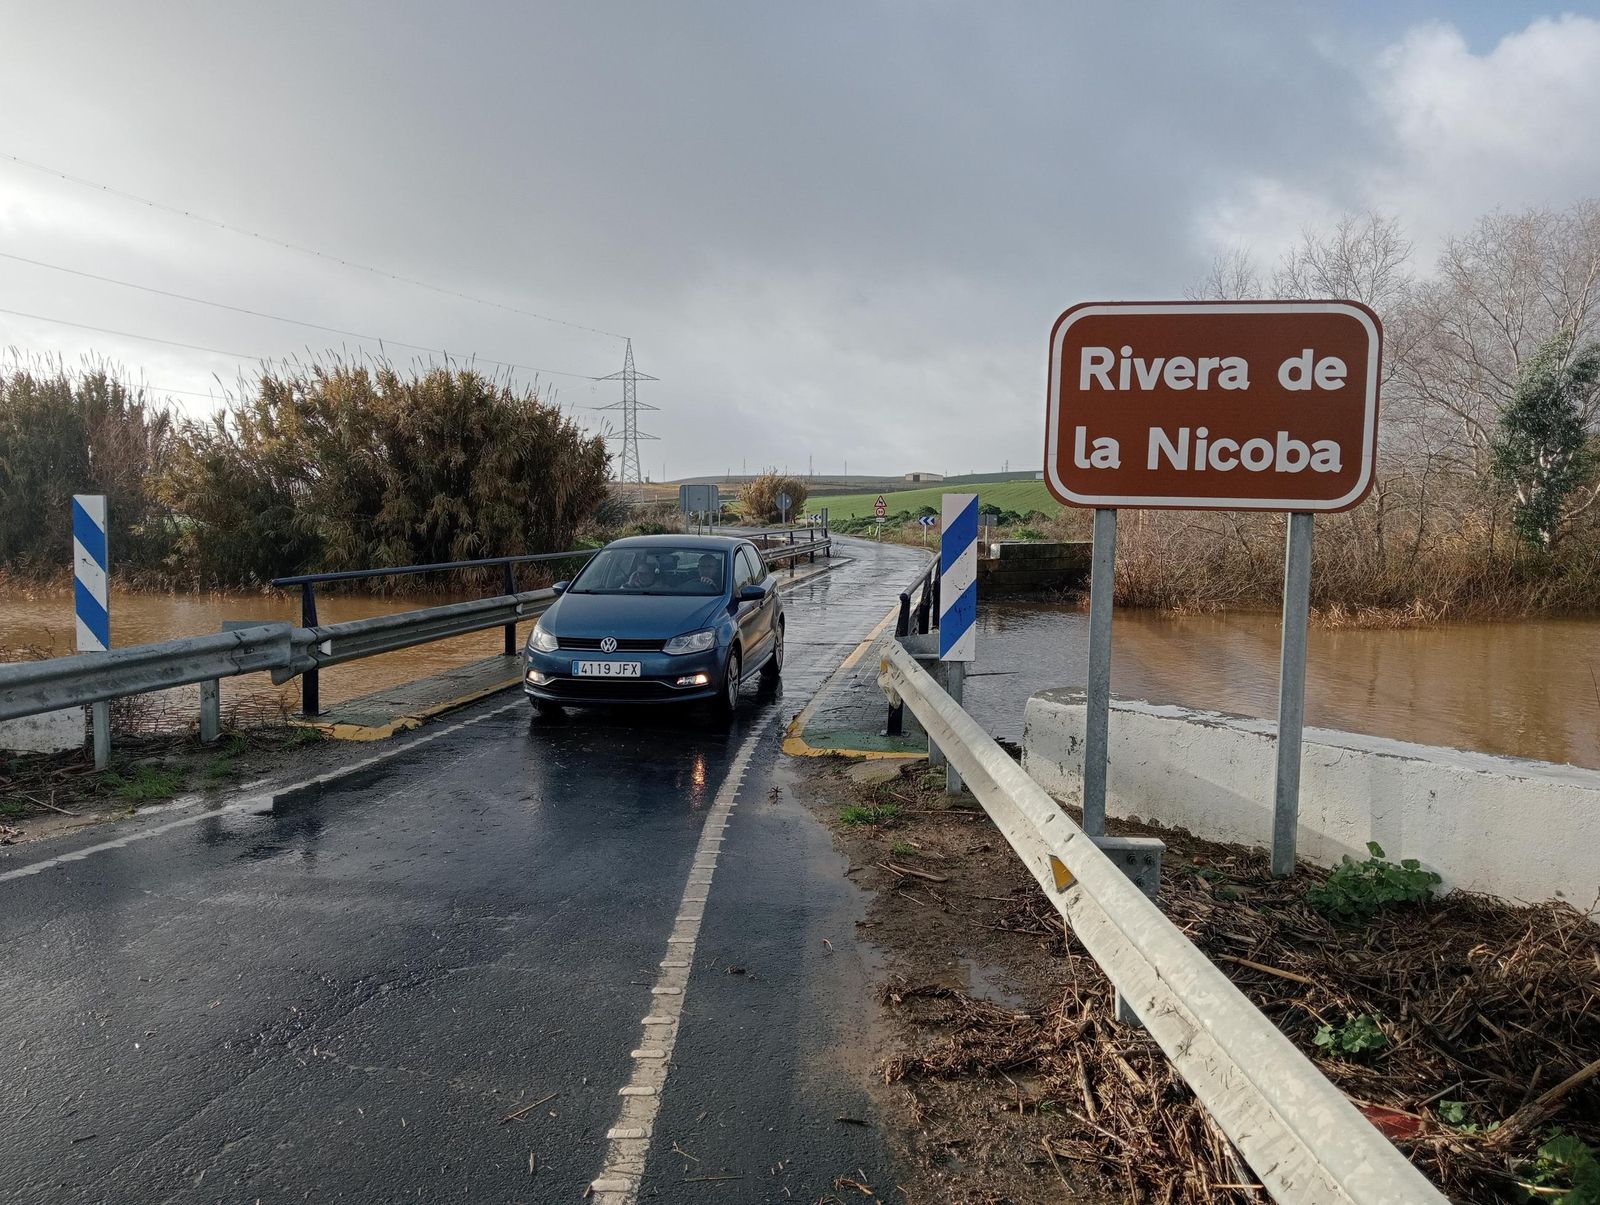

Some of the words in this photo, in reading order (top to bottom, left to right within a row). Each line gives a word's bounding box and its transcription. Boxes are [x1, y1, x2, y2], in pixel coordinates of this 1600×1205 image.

[1079, 345, 1250, 391] Rivera
[1277, 348, 1348, 392] de
[1074, 426, 1122, 470] la
[1147, 426, 1343, 473] Nicoba
[581, 663, 611, 675] 4119
[615, 664, 638, 676] JFX
